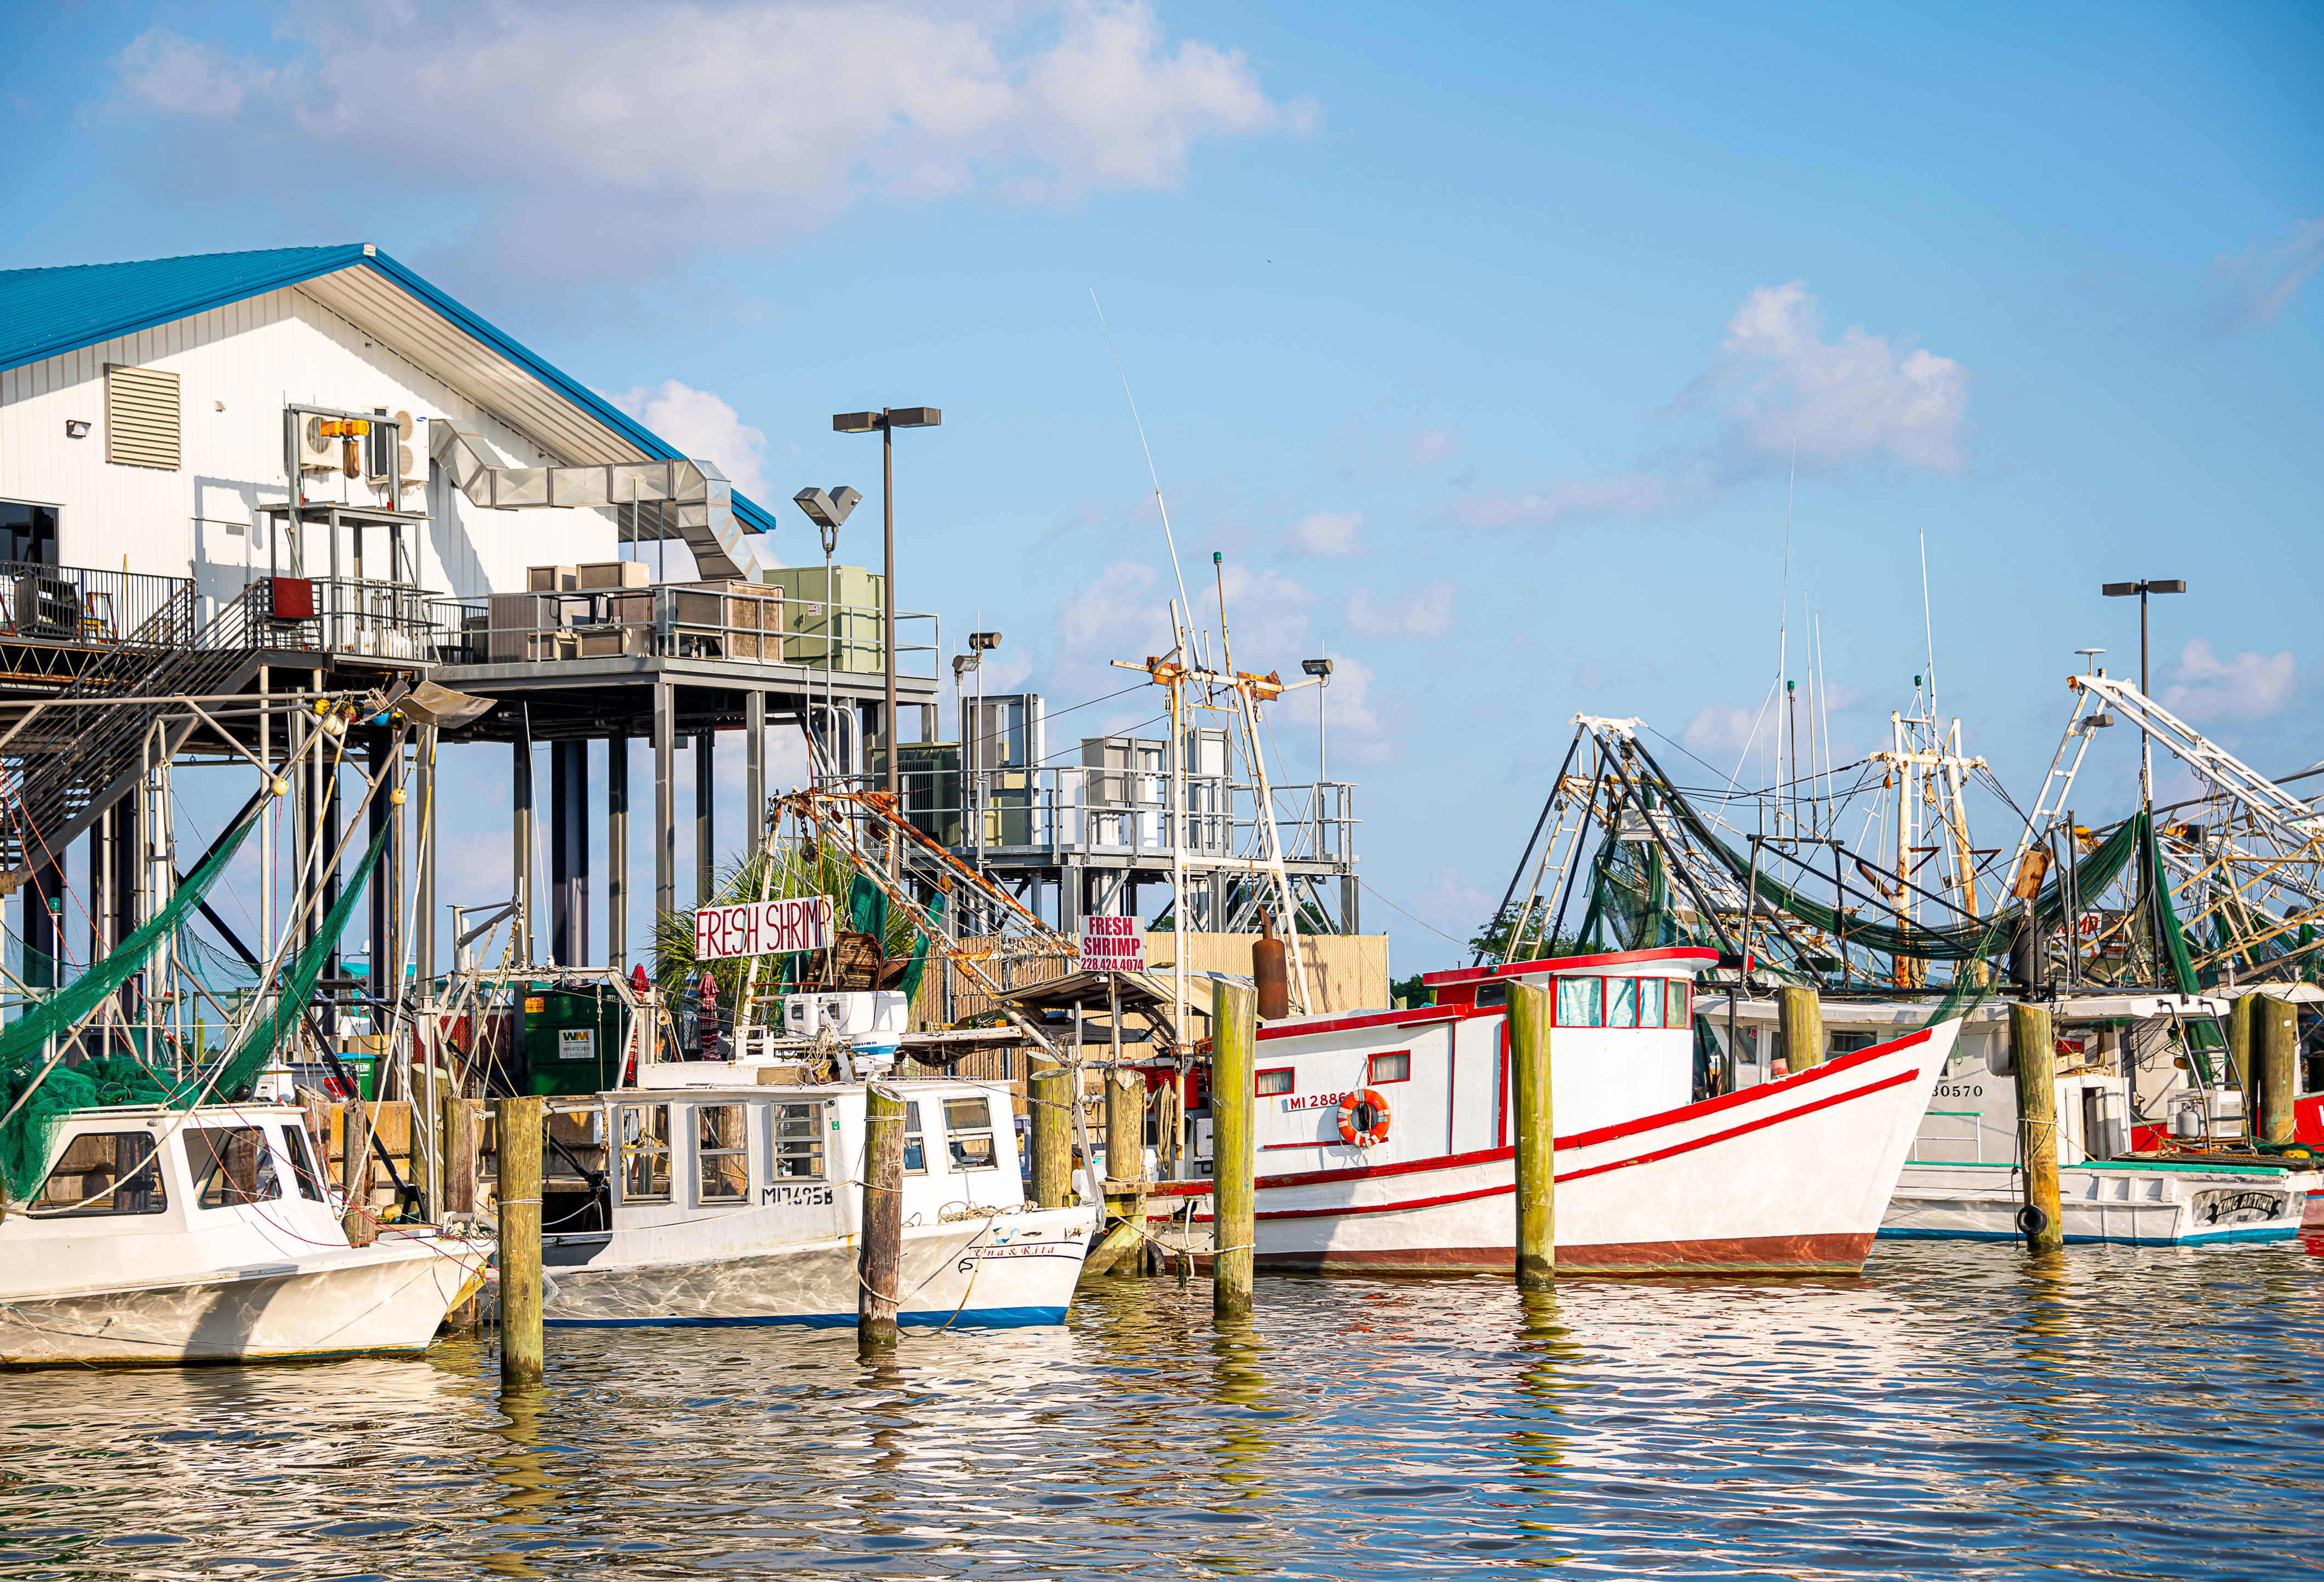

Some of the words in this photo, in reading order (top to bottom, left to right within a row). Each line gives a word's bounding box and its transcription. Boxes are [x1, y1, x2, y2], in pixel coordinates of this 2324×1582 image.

[696, 906, 759, 959] FRESH
[766, 899, 831, 950] SHRIMP
[1089, 916, 1133, 936] FRESH
[1084, 936, 1140, 956] SHRIMP
[1080, 957, 1144, 971] 228.424.4074
[563, 1031, 589, 1041] WM
[1290, 1097, 1306, 1110] MI
[2217, 1196, 2239, 1216] KING
[2240, 1194, 2273, 1212] ARTHUR
[1021, 1246, 1055, 1255] Rita
